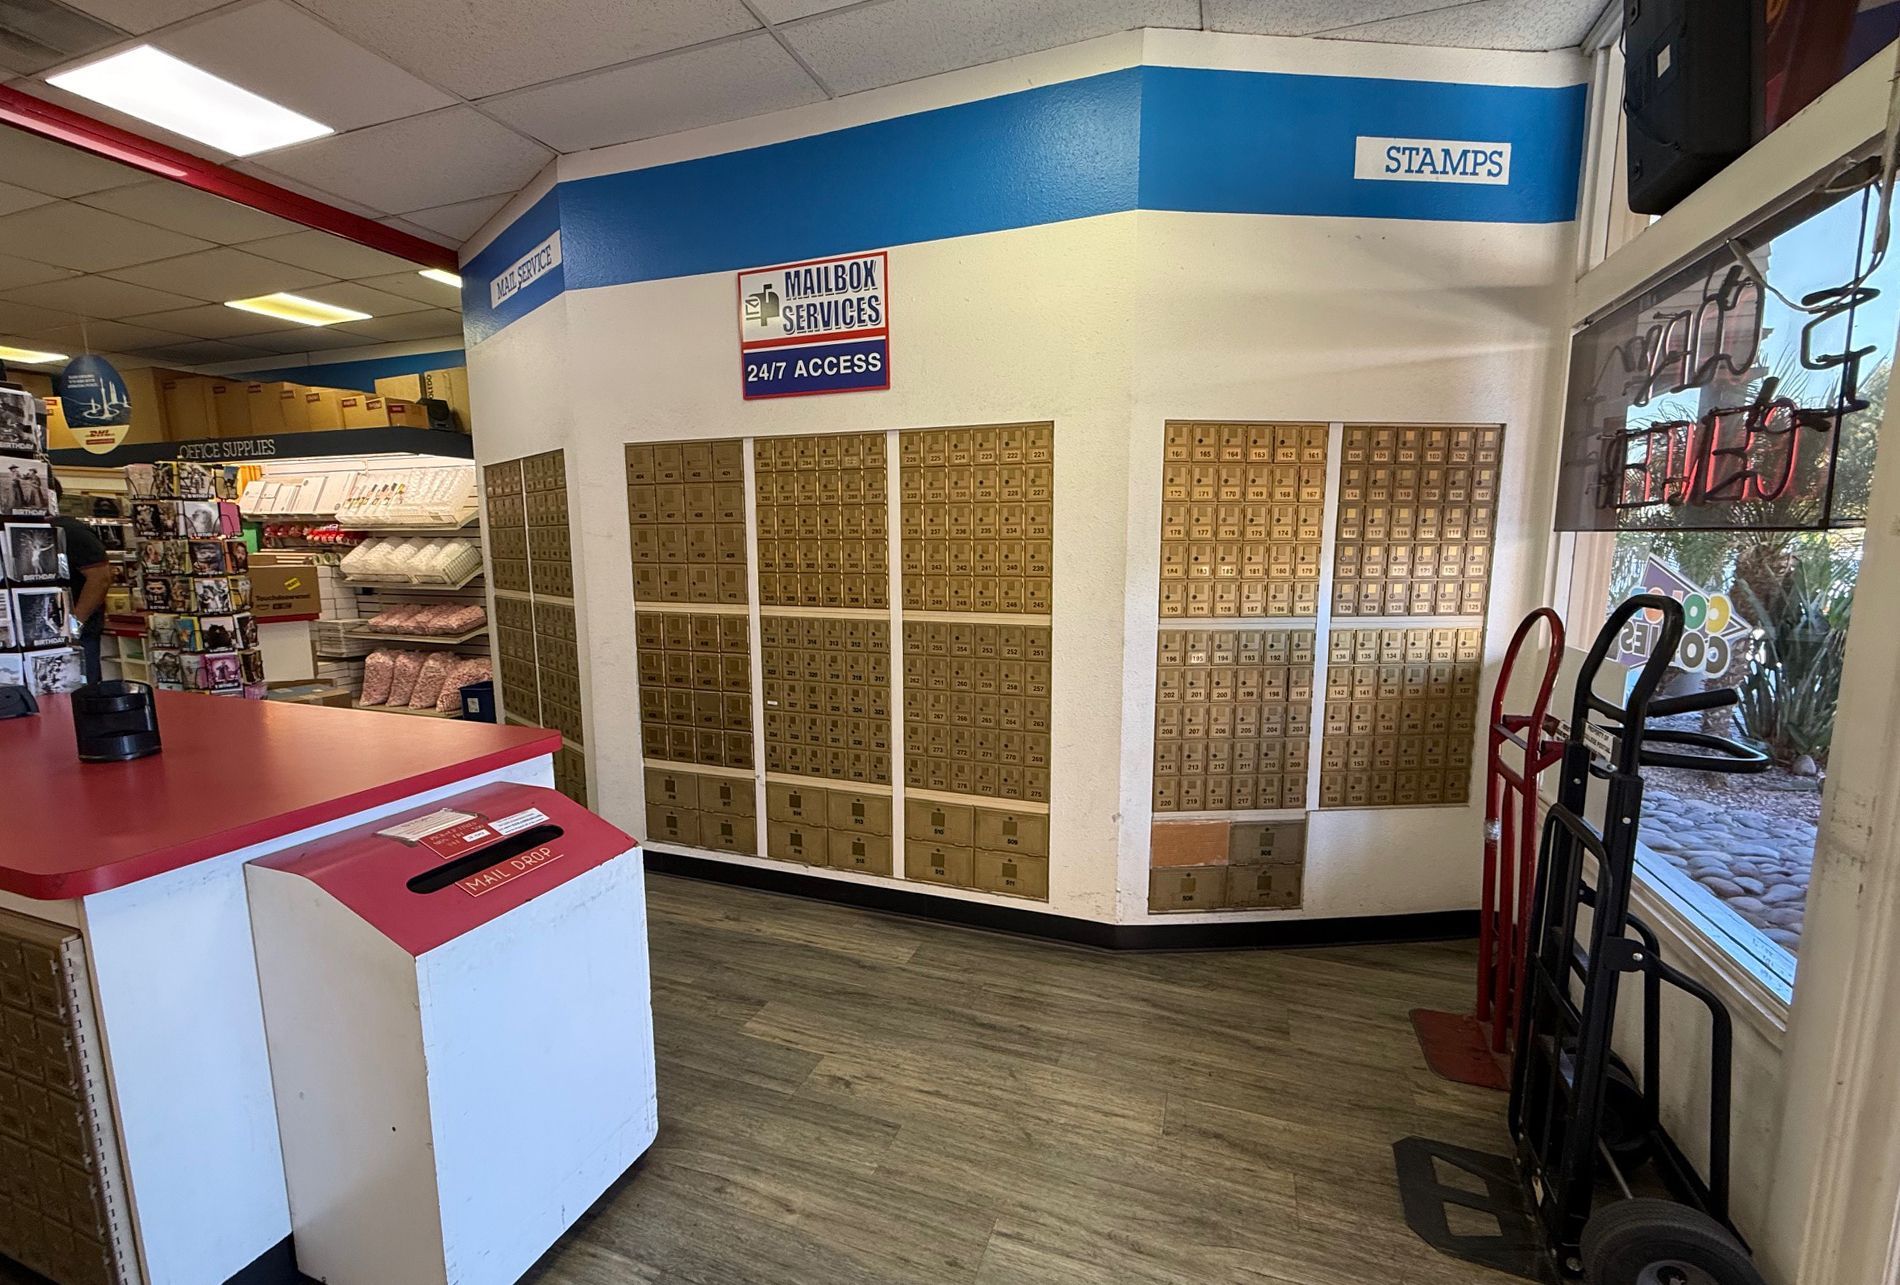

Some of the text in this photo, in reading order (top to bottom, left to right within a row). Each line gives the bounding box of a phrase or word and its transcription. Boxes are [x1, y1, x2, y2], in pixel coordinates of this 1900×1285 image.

[1385, 145, 1503, 178] STAMPS
[496, 244, 552, 300] MAIL SERVICE
[785, 259, 877, 300] MAILBOX
[782, 294, 881, 334] SERVICES
[747, 352, 882, 382] 24/7 ACCESS
[180, 439, 276, 459] OFFICE SUPPLIES
[1200, 450, 1211, 458] 165
[1282, 451, 1294, 459] 162
[1225, 490, 1237, 498] 170
[12, 508, 47, 516] BIRTHDAY
[23, 573, 57, 581] BIRTHDAY
[1032, 601, 1045, 609] 245
[33, 637, 65, 646] BIRTHDAY
[981, 681, 993, 689] 259
[1005, 753, 1017, 761] 270
[1030, 790, 1042, 798] 275
[1237, 797, 1249, 805] 217
[465, 847, 551, 893] MAIL DROP
